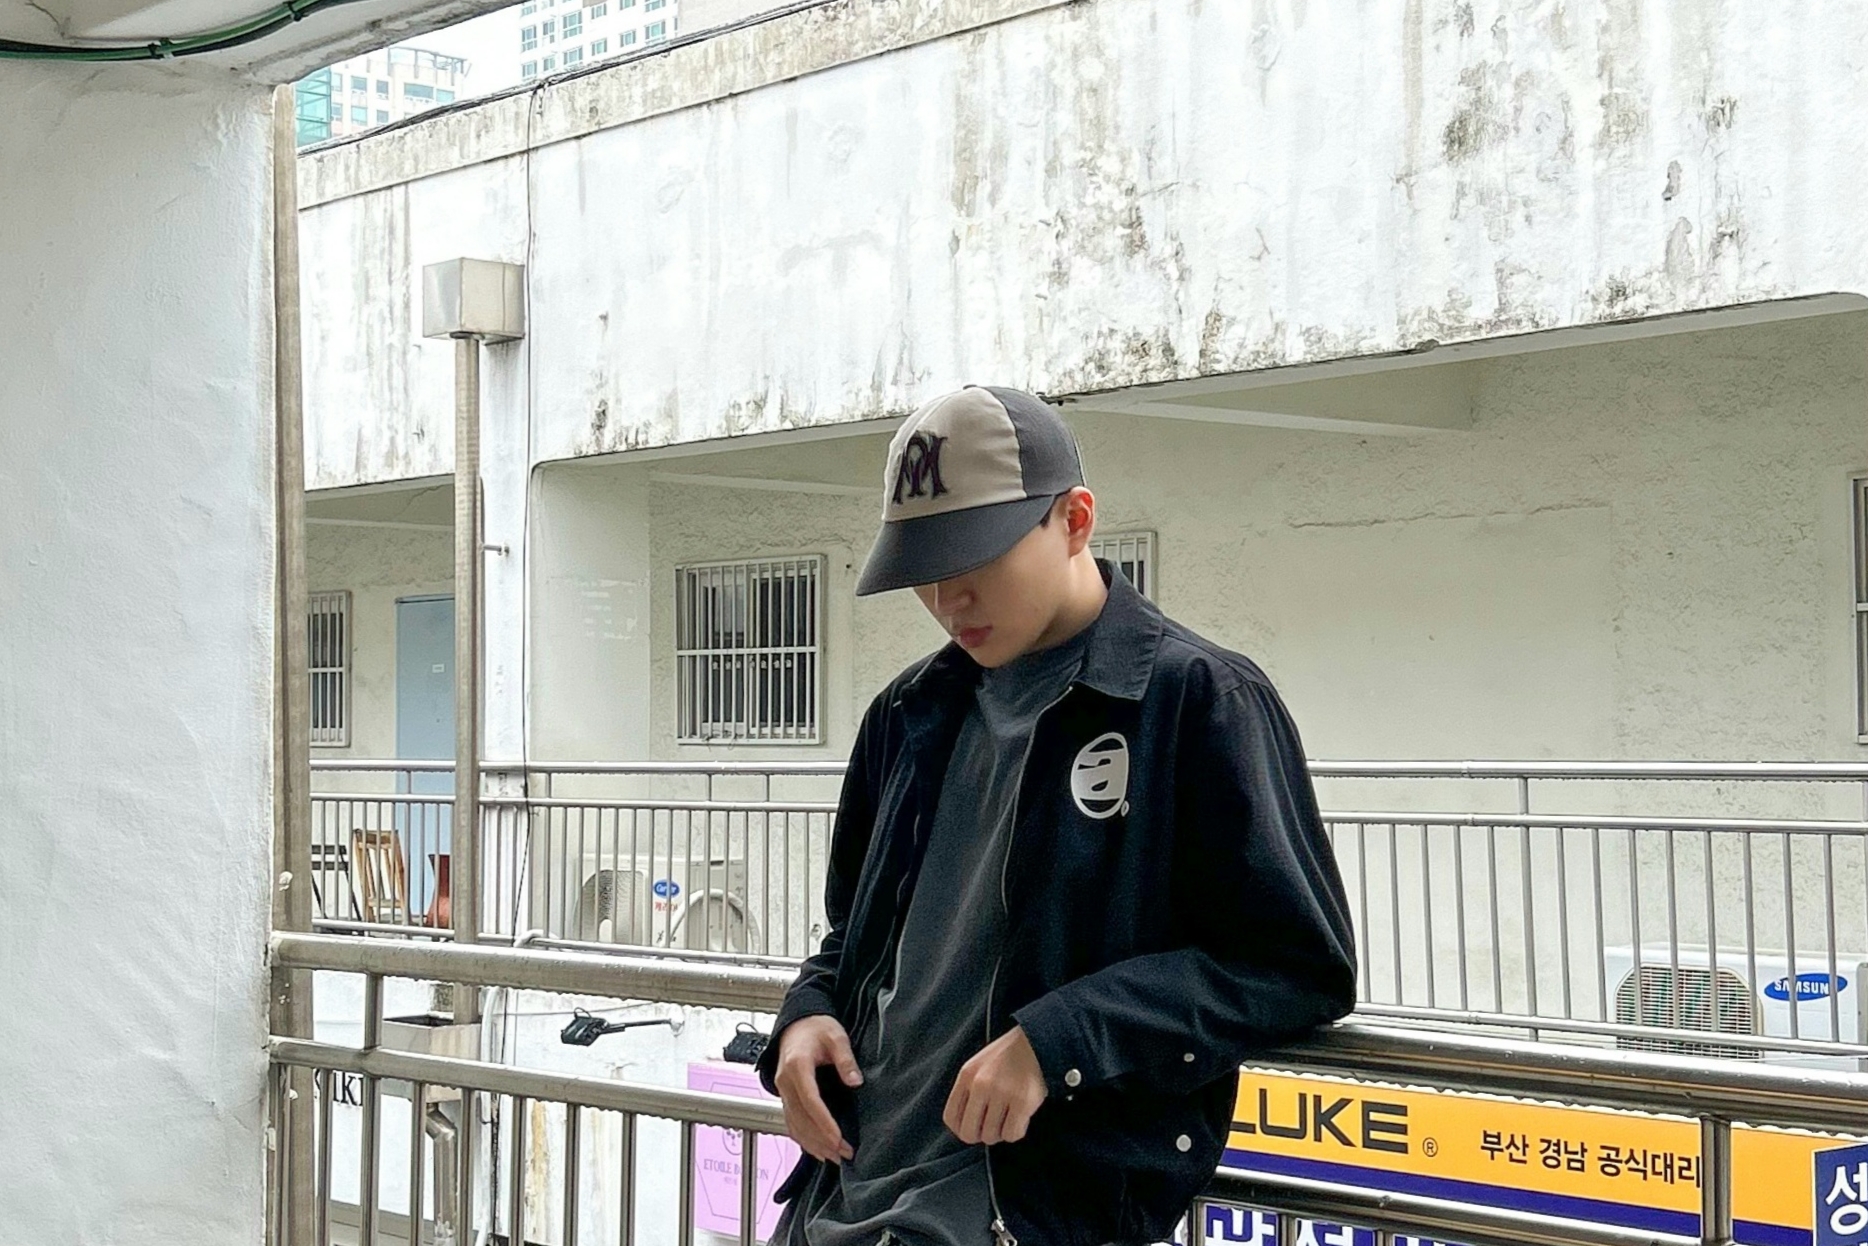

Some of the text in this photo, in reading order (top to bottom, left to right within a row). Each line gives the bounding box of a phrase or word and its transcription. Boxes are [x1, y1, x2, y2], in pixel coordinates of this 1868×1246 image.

[1774, 980, 1830, 995] SAMSUN
[1480, 1129, 1702, 1188] 부산 경남 공식대리
